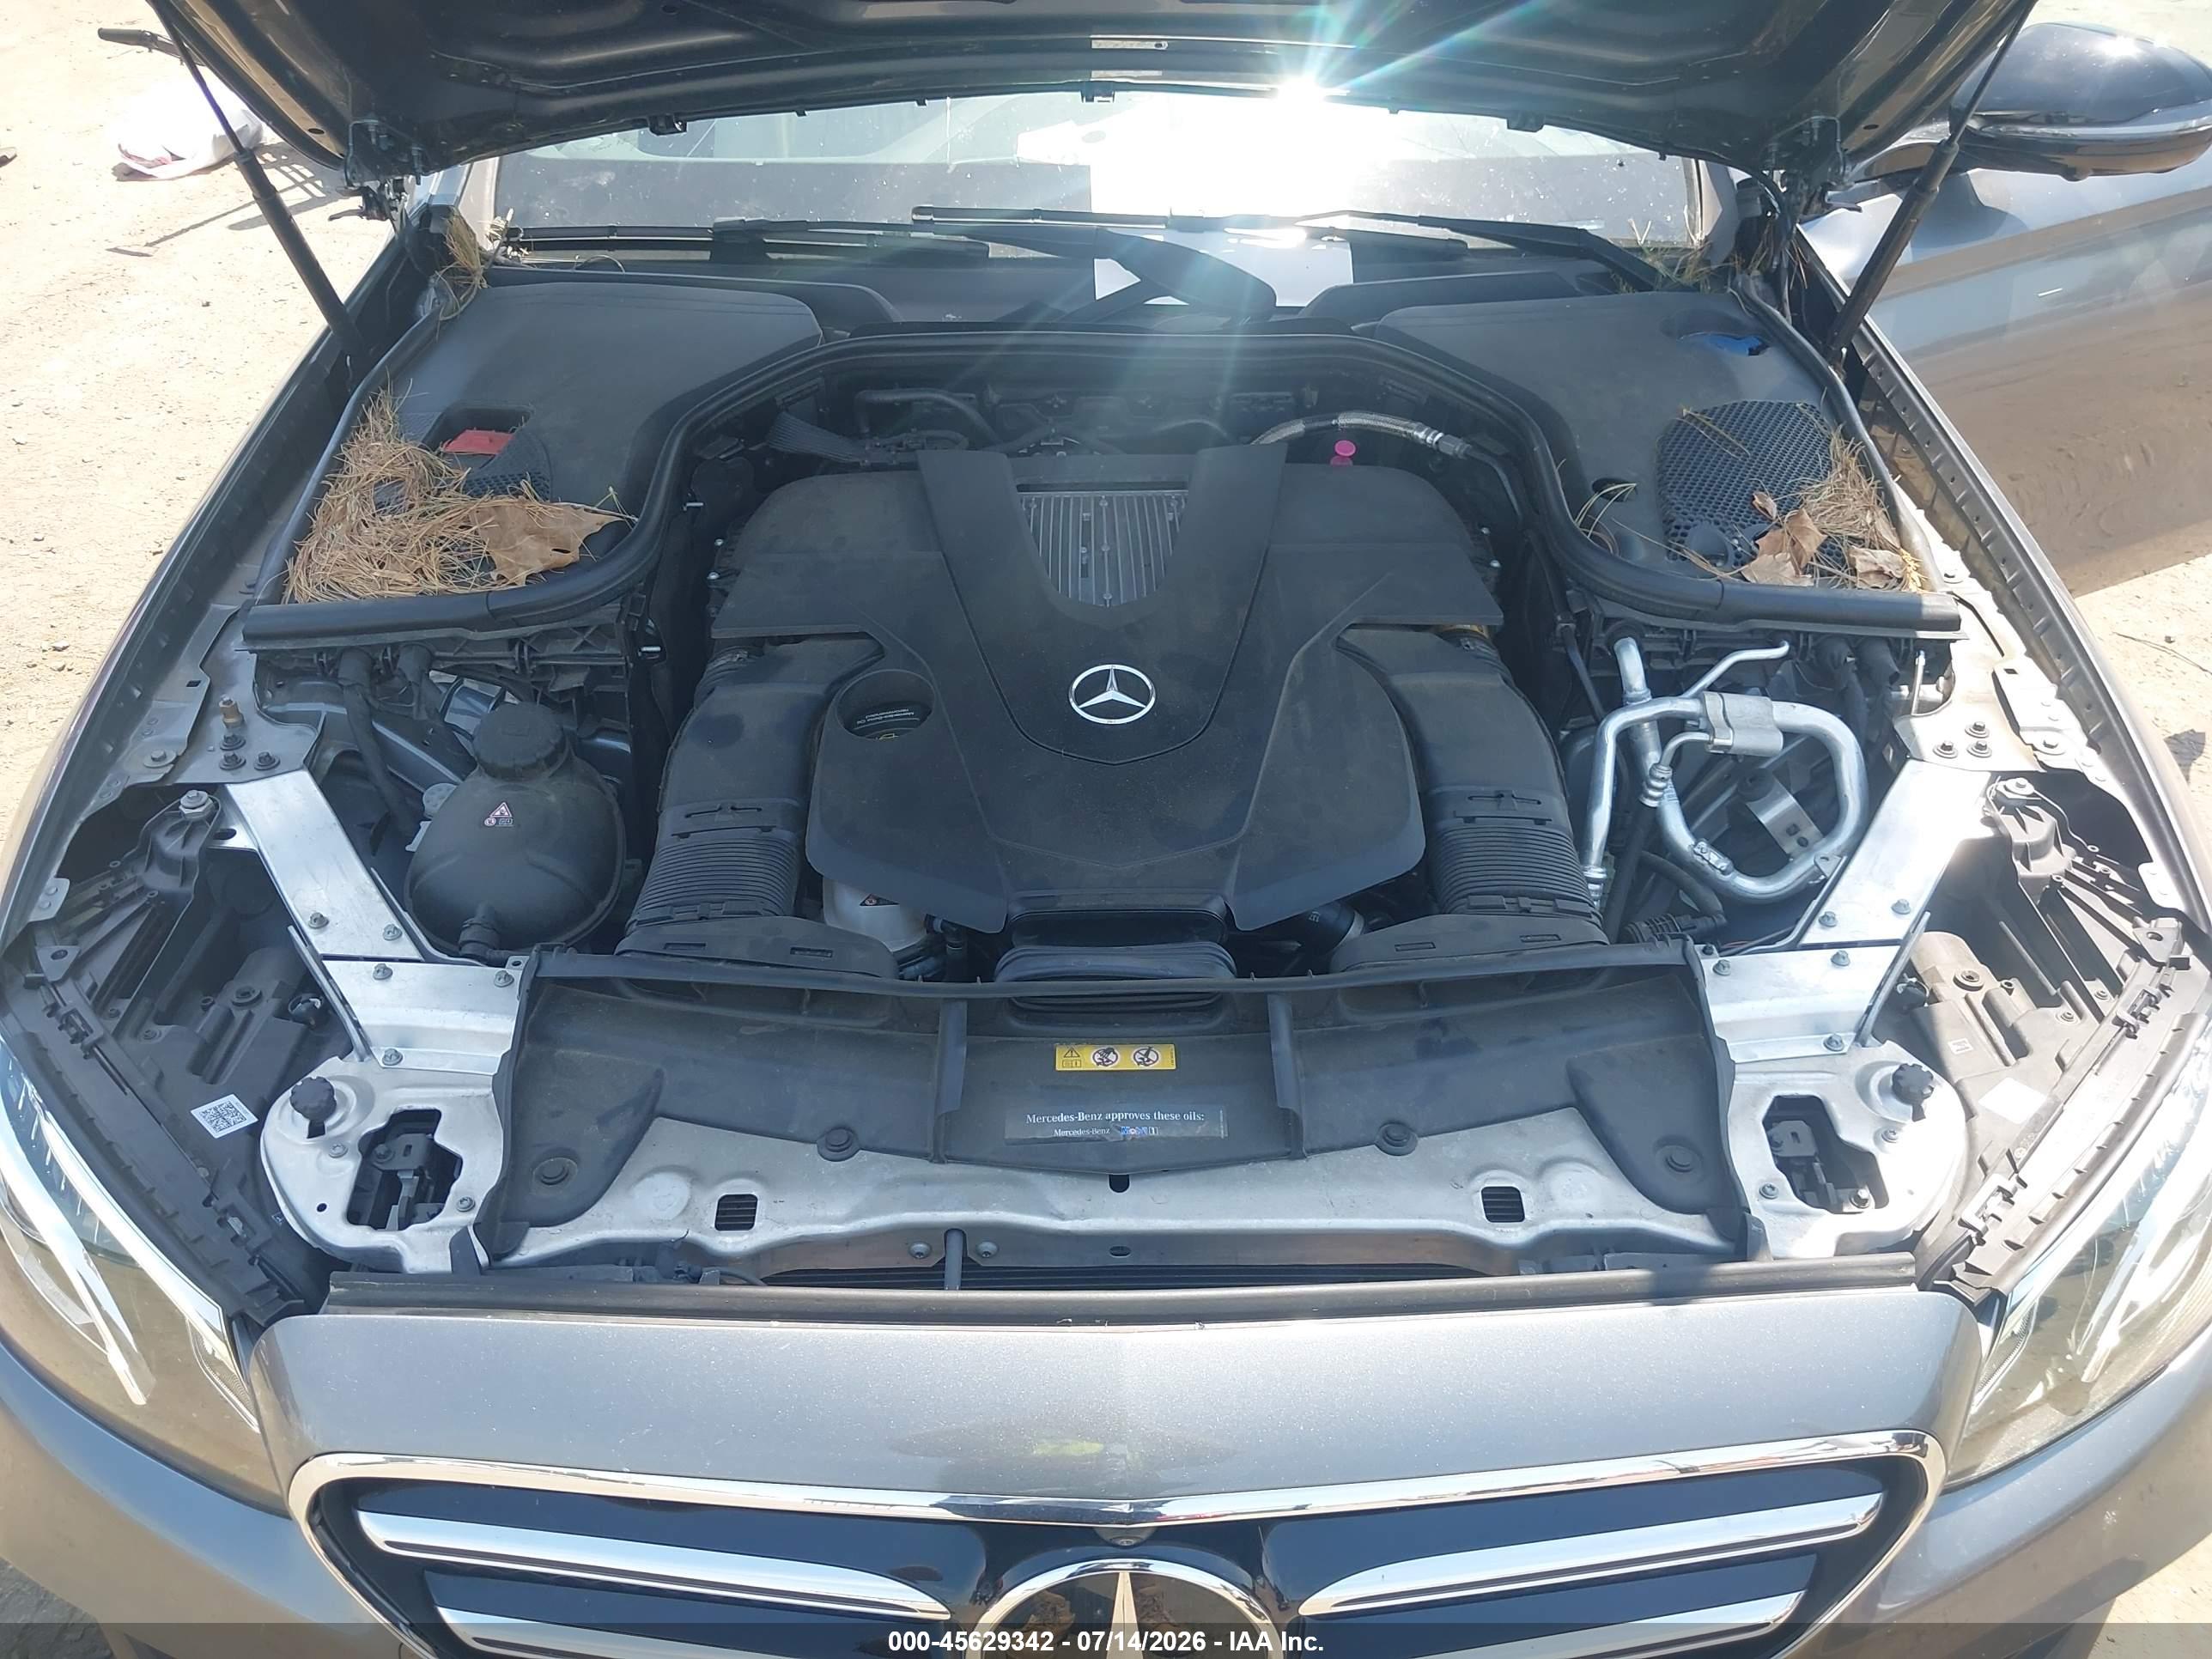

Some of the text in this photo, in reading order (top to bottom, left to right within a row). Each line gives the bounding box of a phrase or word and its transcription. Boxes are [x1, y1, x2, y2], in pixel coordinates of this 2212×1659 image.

[1025, 1110, 1205, 1124] Mercedes-Benz approves these oils:
[1054, 1127, 1111, 1137] Mercedes-Benz
